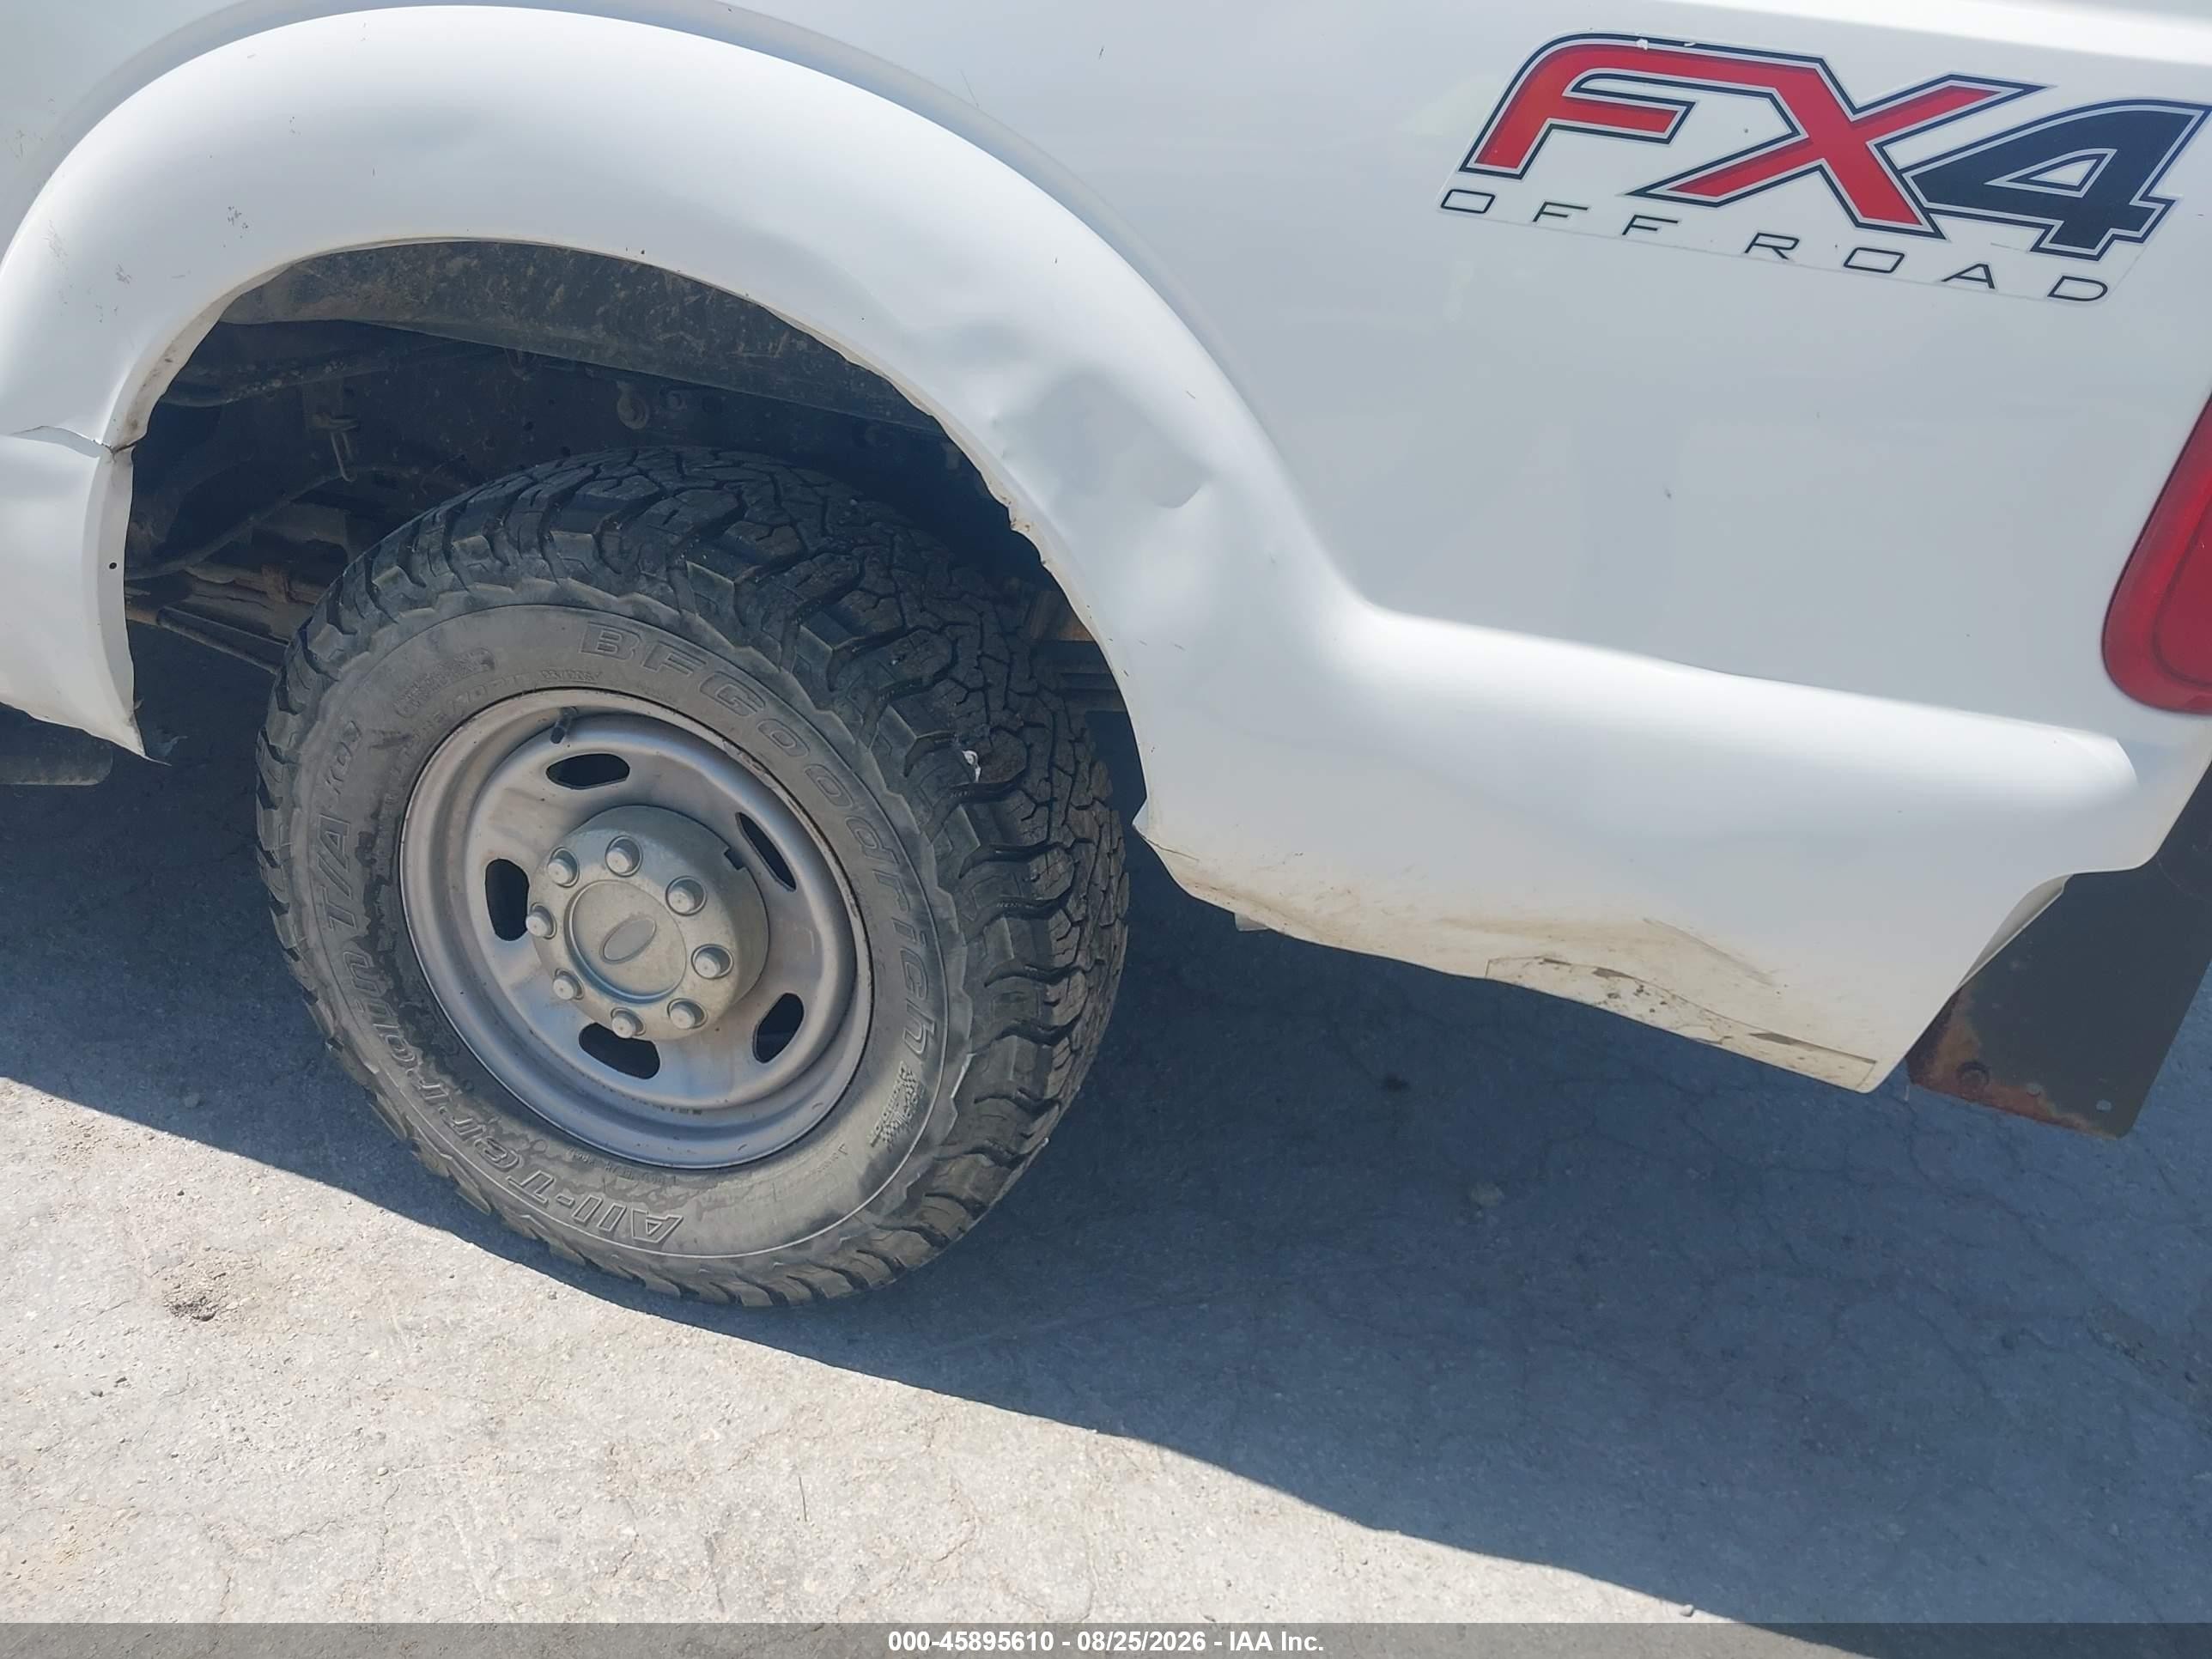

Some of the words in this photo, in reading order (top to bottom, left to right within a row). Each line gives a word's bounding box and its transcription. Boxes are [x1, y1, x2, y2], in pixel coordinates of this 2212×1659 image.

[1439, 188, 1680, 238] OFF
[1743, 233, 2109, 304] ROAD
[1458, 30, 2211, 261] FX4
[579, 621, 937, 1055] BFGoodrich
